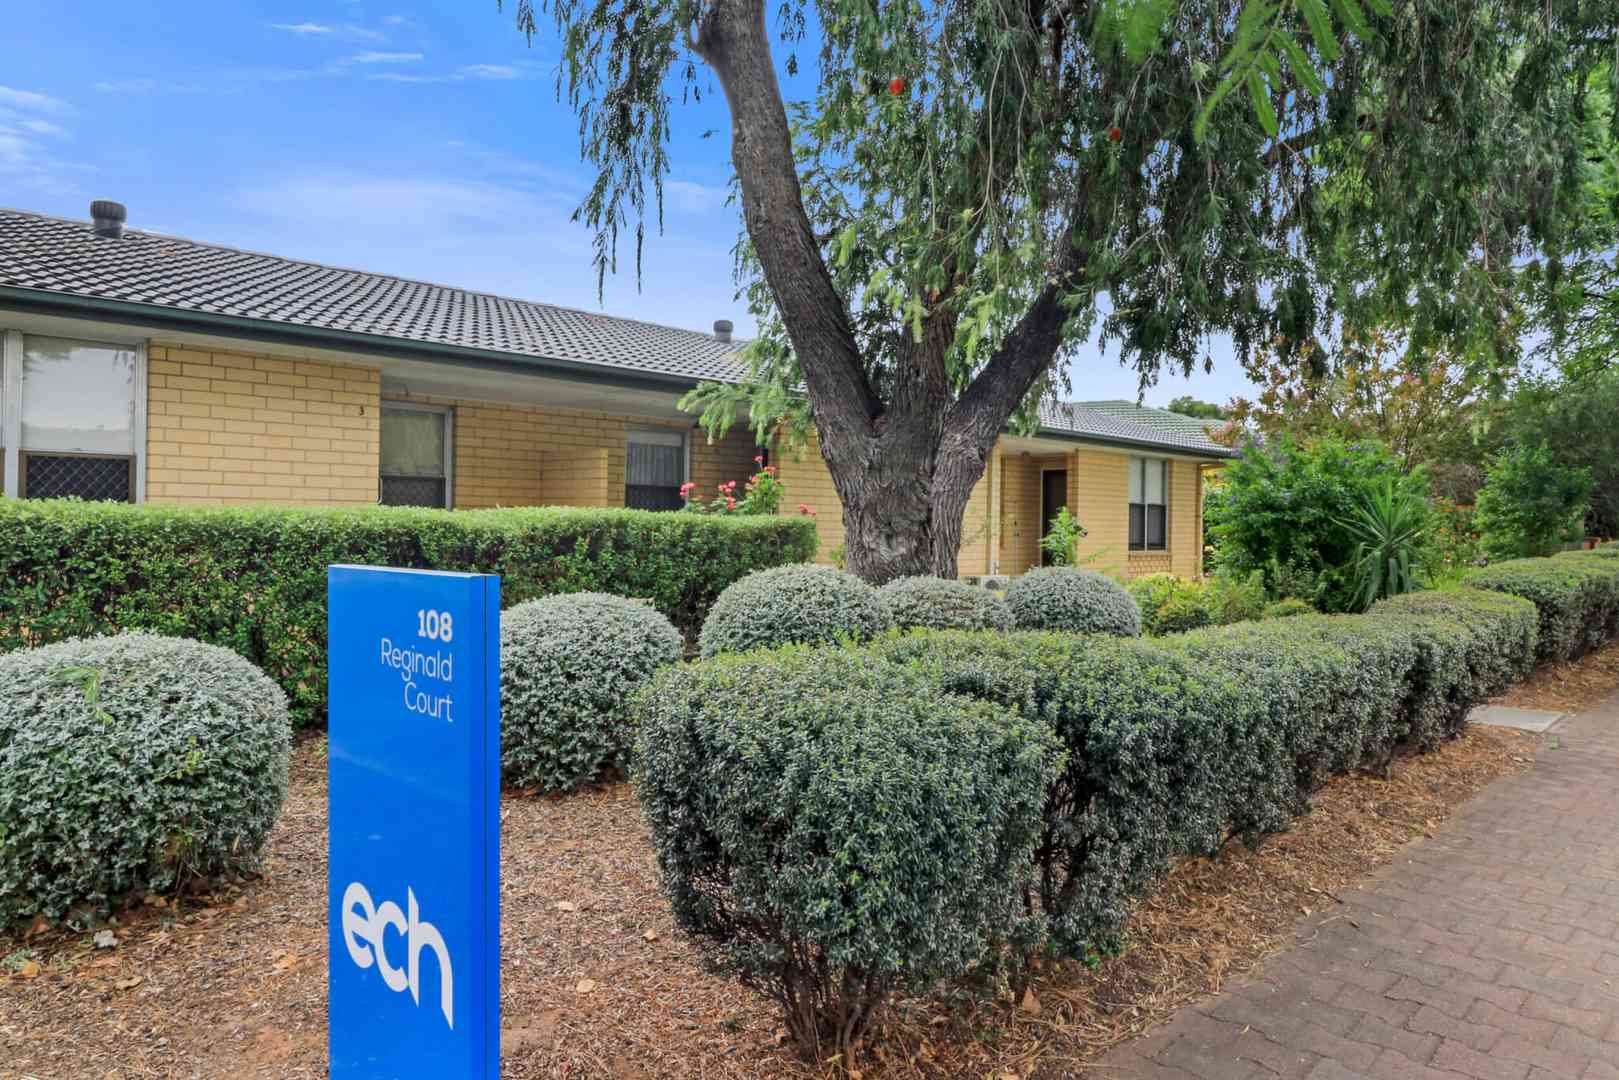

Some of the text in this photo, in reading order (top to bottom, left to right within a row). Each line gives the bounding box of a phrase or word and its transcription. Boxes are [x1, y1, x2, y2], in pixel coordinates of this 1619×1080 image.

[417, 609, 453, 642] 108
[381, 638, 453, 682] Reginald
[404, 682, 453, 722] Court
[342, 882, 453, 1029] ech
